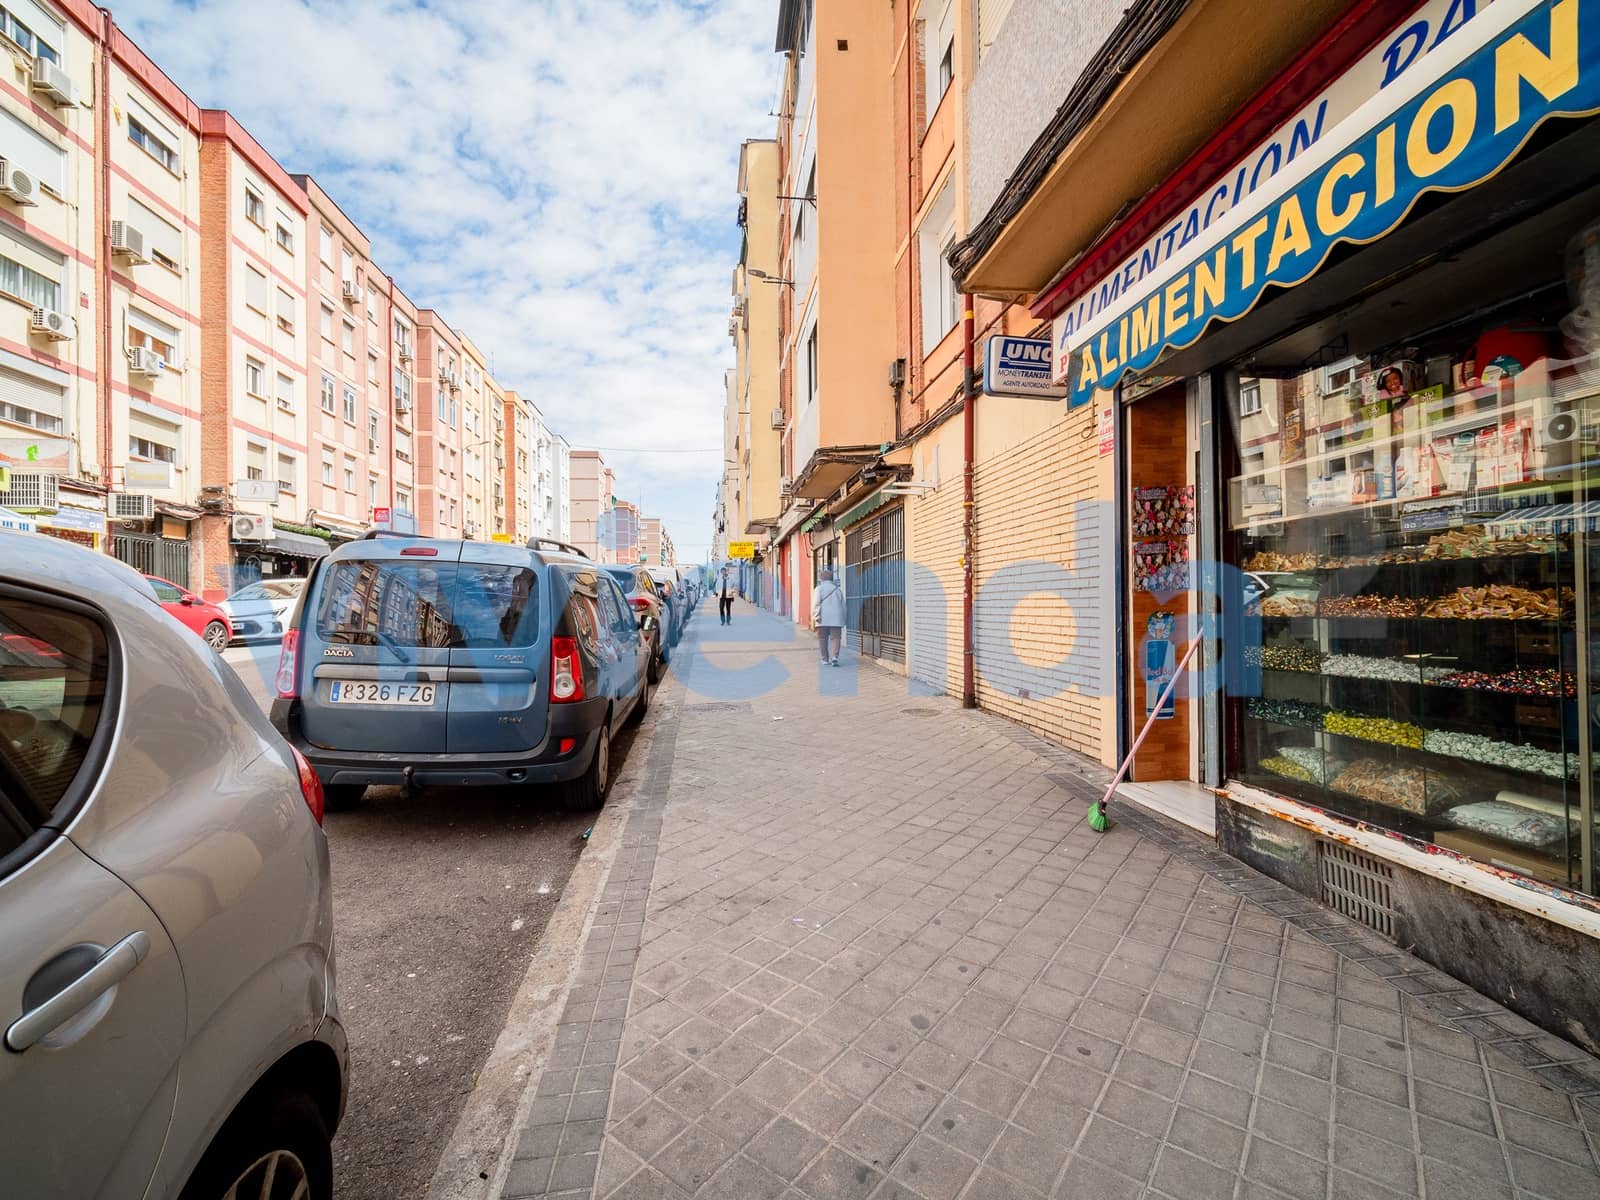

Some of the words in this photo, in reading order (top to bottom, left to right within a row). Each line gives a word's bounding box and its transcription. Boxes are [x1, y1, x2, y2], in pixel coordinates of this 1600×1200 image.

[1060, 98, 1329, 350] ALIMENTACION
[1077, 0, 1579, 393] ALIMENTACION
[323, 649, 354, 657] DACIA
[343, 683, 391, 702] 8326
[396, 685, 433, 703] FZG
